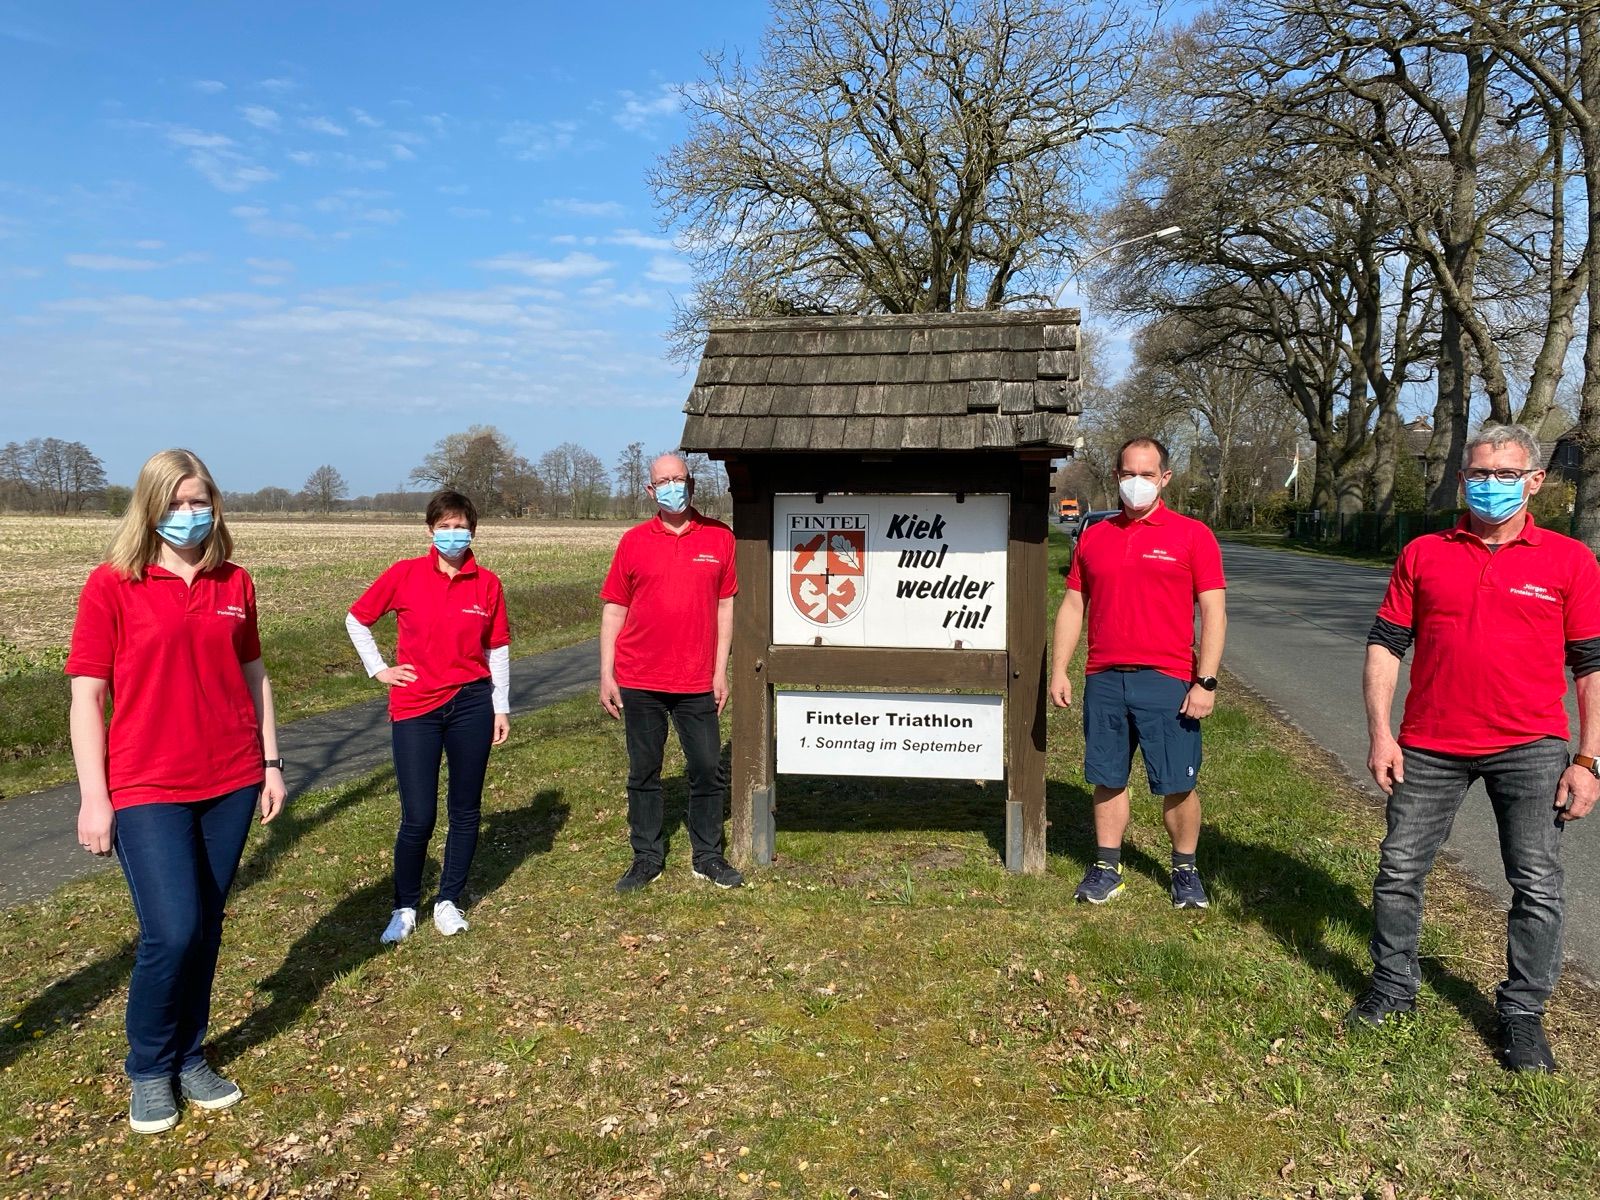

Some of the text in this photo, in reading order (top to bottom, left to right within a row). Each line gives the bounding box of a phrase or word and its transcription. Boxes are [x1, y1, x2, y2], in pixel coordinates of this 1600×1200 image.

[791, 516, 866, 530] FINTEL
[886, 513, 947, 540] Kiek
[897, 543, 949, 569] mol
[896, 575, 995, 600] wedder
[942, 604, 992, 630] rin!
[806, 711, 974, 728] Finteler Triathlon
[799, 736, 983, 754] 1. Sonntag im September
